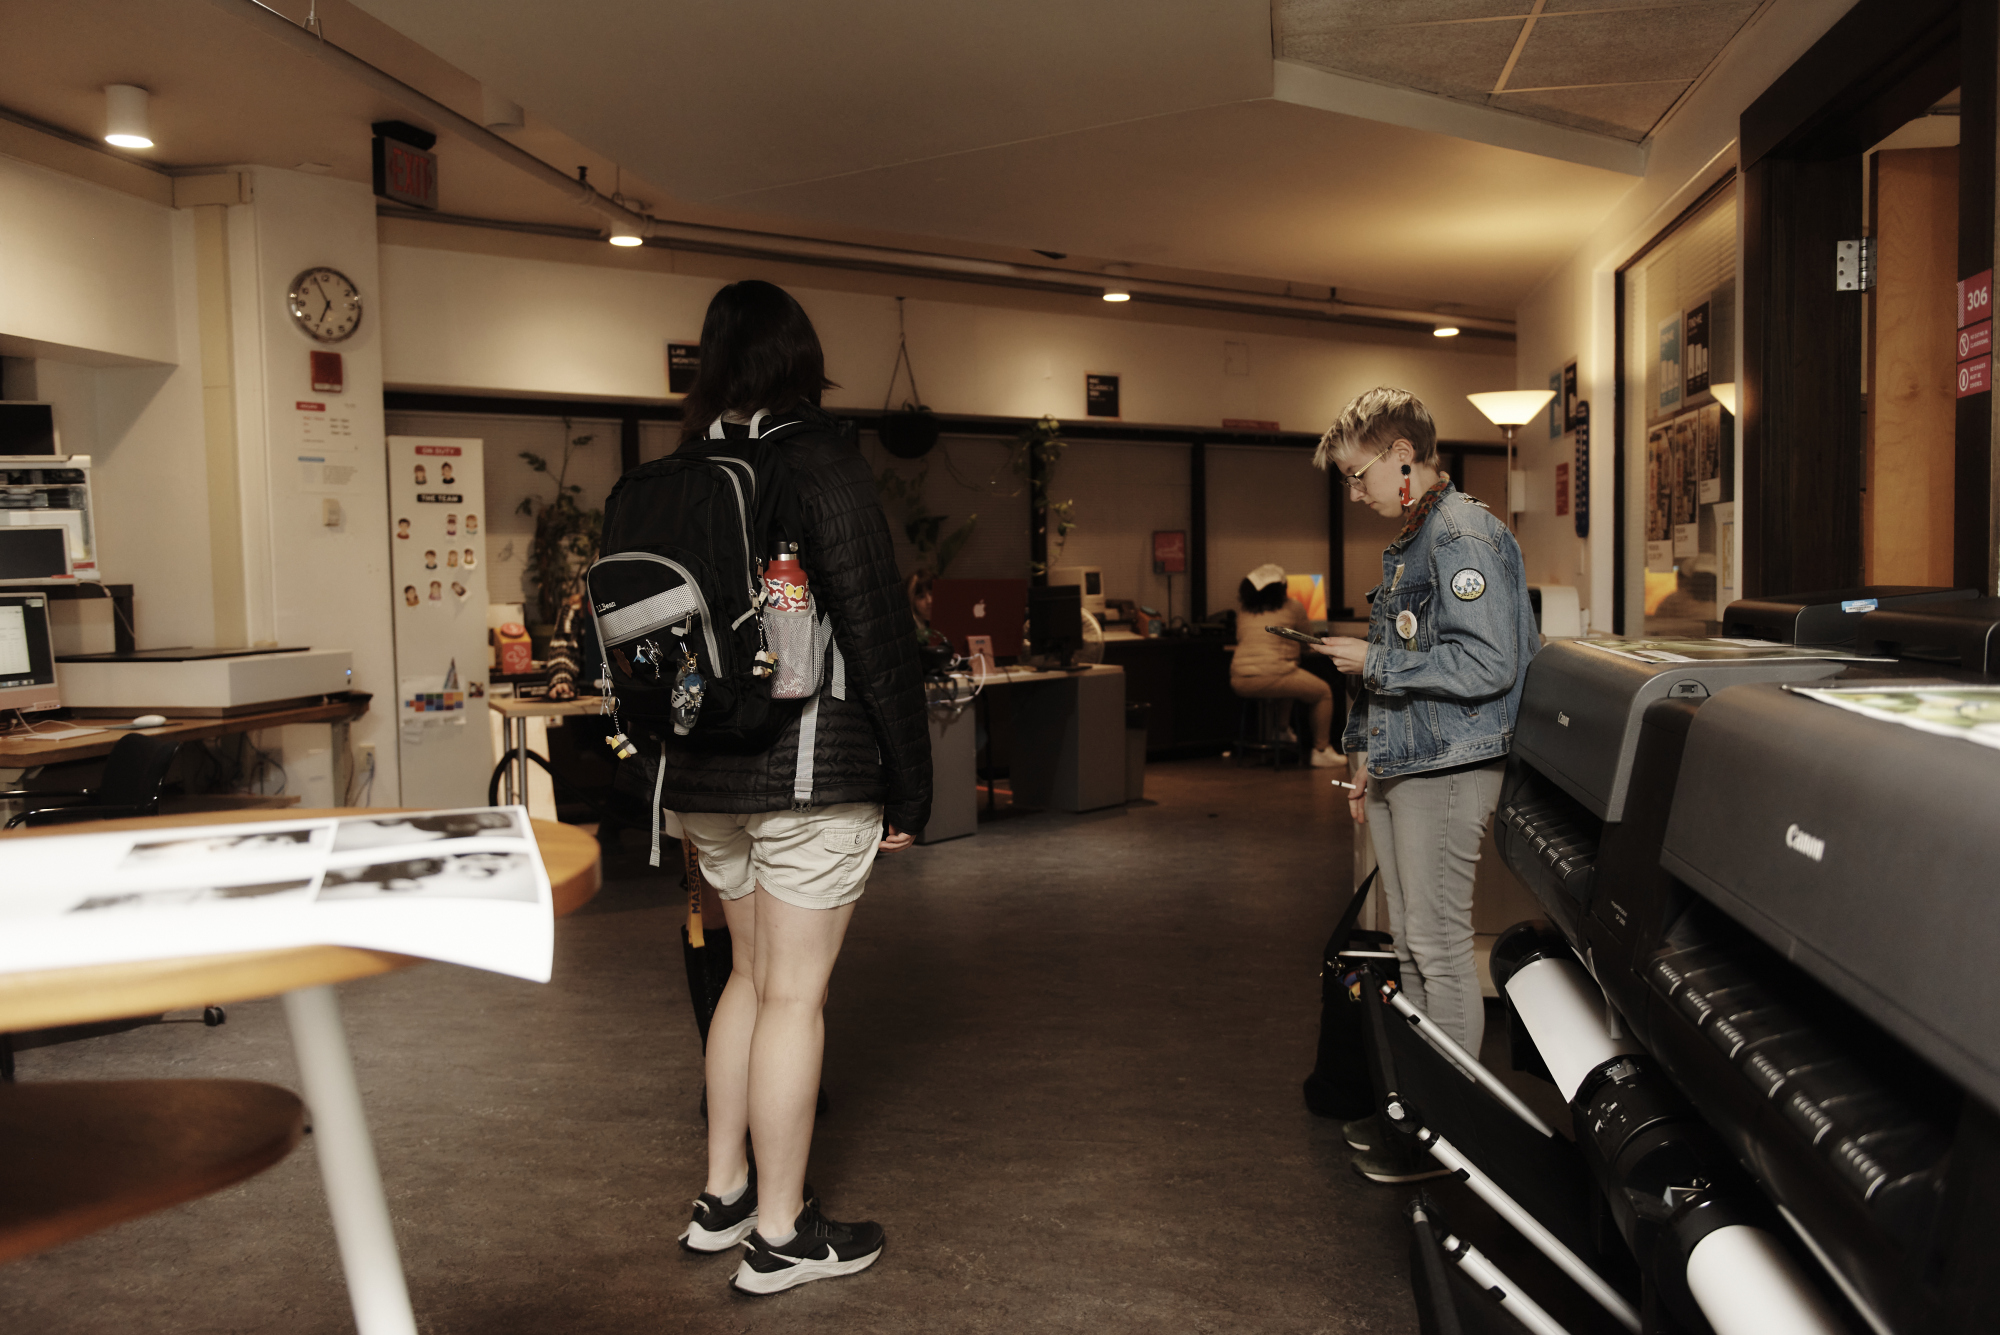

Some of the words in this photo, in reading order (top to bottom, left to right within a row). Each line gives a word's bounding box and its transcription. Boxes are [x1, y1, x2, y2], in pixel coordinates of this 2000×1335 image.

[393, 147, 430, 200] EXIT
[321, 274, 330, 282] 12
[344, 288, 352, 297] 2
[1966, 287, 1987, 311] 306
[298, 300, 306, 308] 9
[304, 313, 312, 321] 8
[314, 324, 321, 333] 7
[326, 328, 334, 336] 6
[671, 348, 686, 356] LAB
[434, 447, 455, 455] DUTY
[421, 494, 436, 502] THE
[437, 494, 459, 502] TEAM
[1558, 711, 1570, 727] Canon
[1785, 823, 1826, 863] Canon
[689, 849, 701, 914] MASSART
